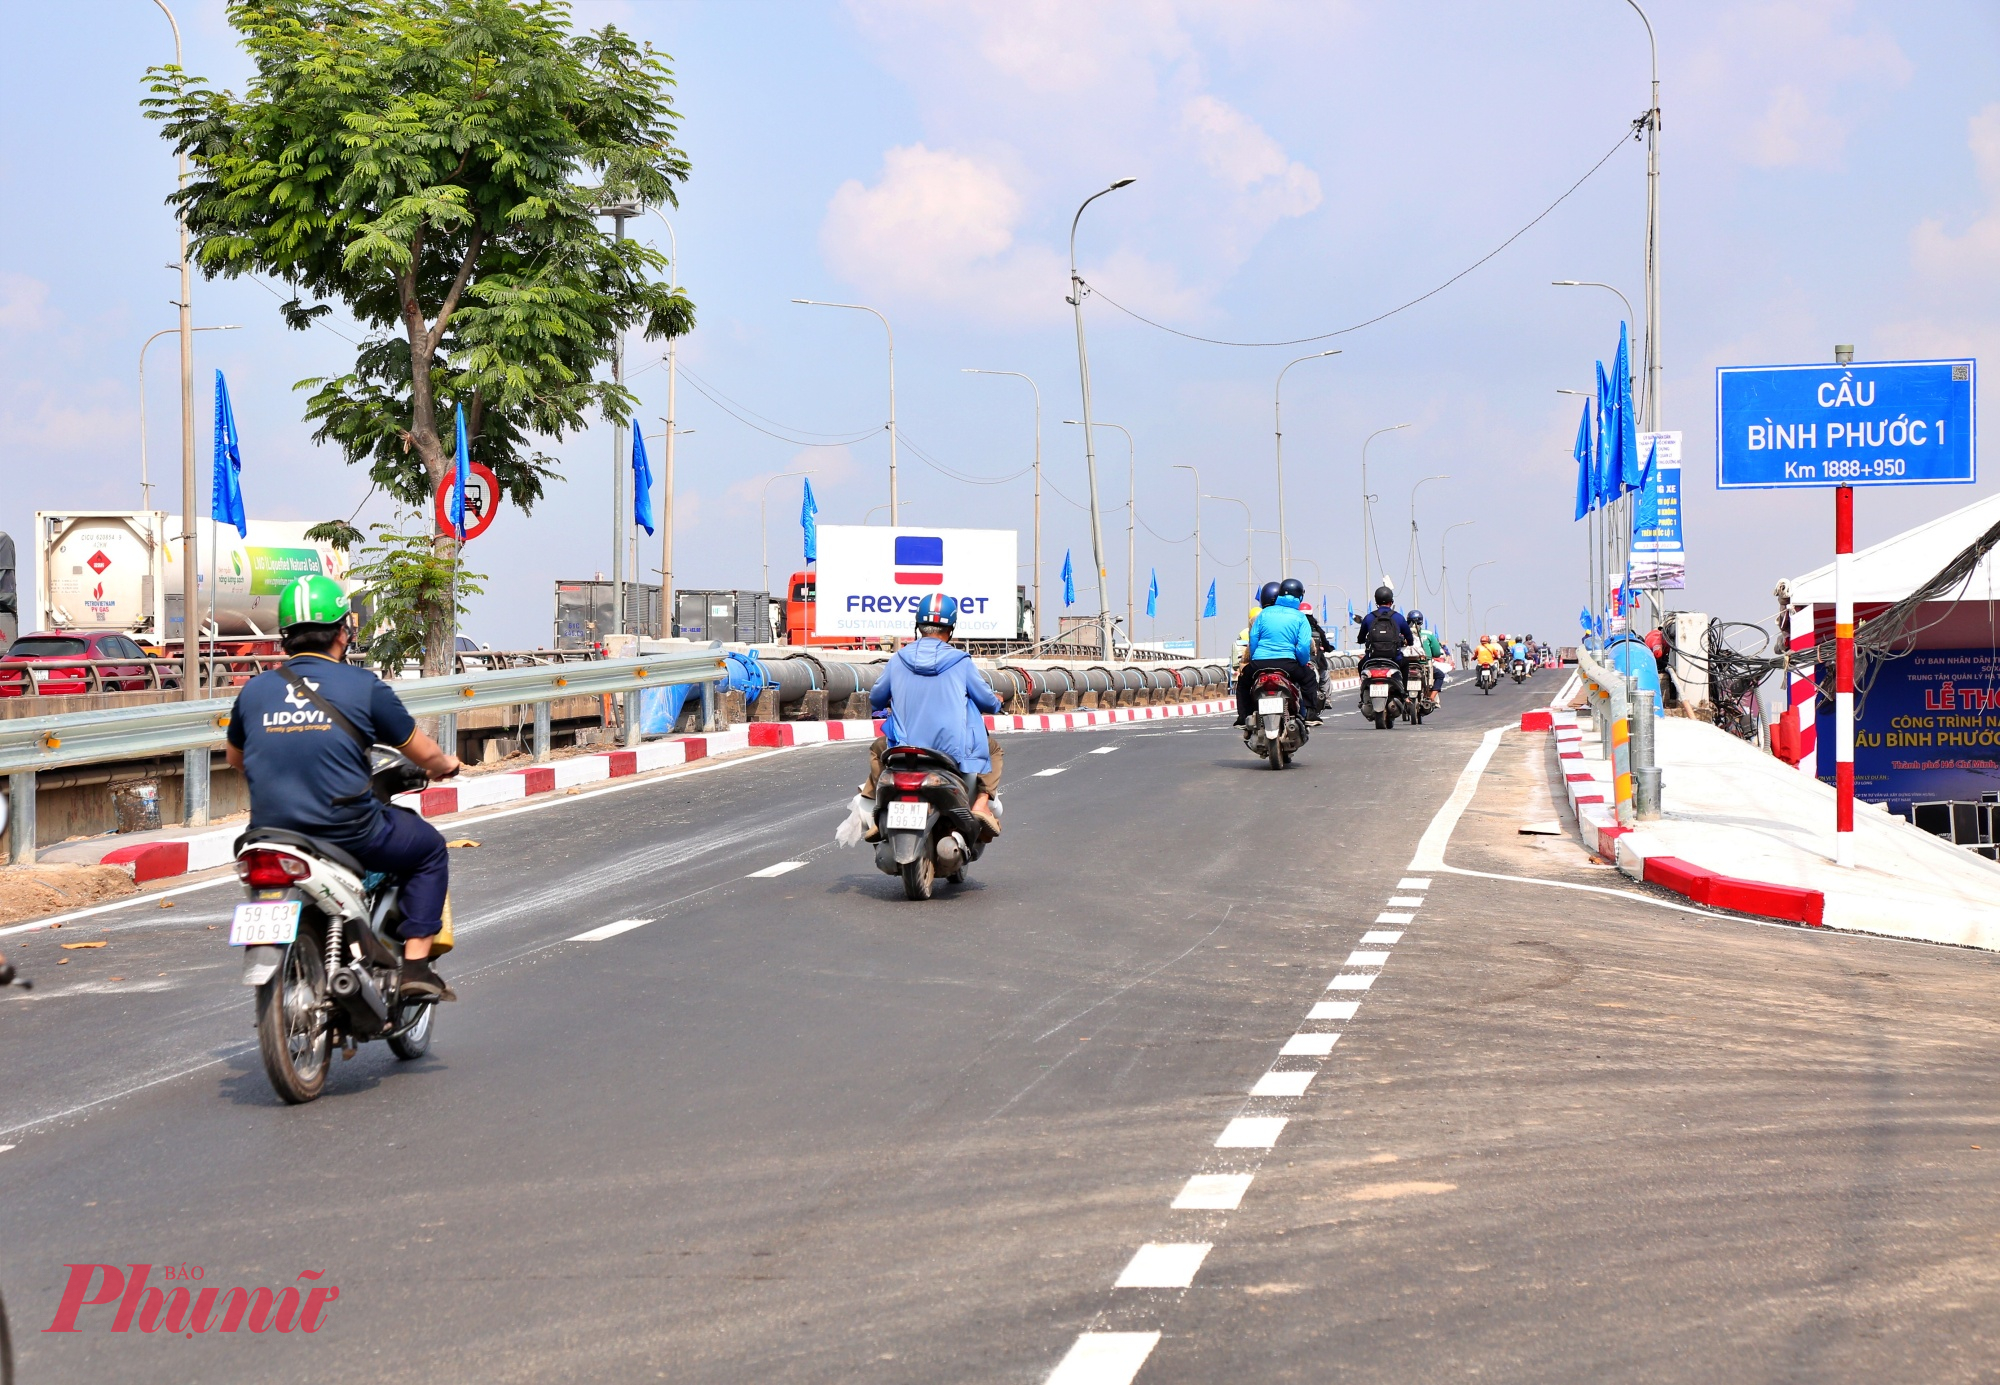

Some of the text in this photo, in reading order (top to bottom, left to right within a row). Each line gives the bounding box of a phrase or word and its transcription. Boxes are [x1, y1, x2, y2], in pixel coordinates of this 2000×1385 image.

[1817, 371, 1875, 408] CẦU
[1748, 413, 1945, 450] BÌNH PHƯỚC 1
[1785, 458, 1906, 479] Km 1888+950
[1928, 657, 1945, 665] BAN
[1891, 714, 1934, 728] CÔNG
[1937, 715, 1981, 728] TRÌNH
[1855, 728, 1881, 748] ẦU
[1886, 729, 1932, 747] BÌNH
[1892, 760, 1921, 769] Thành
